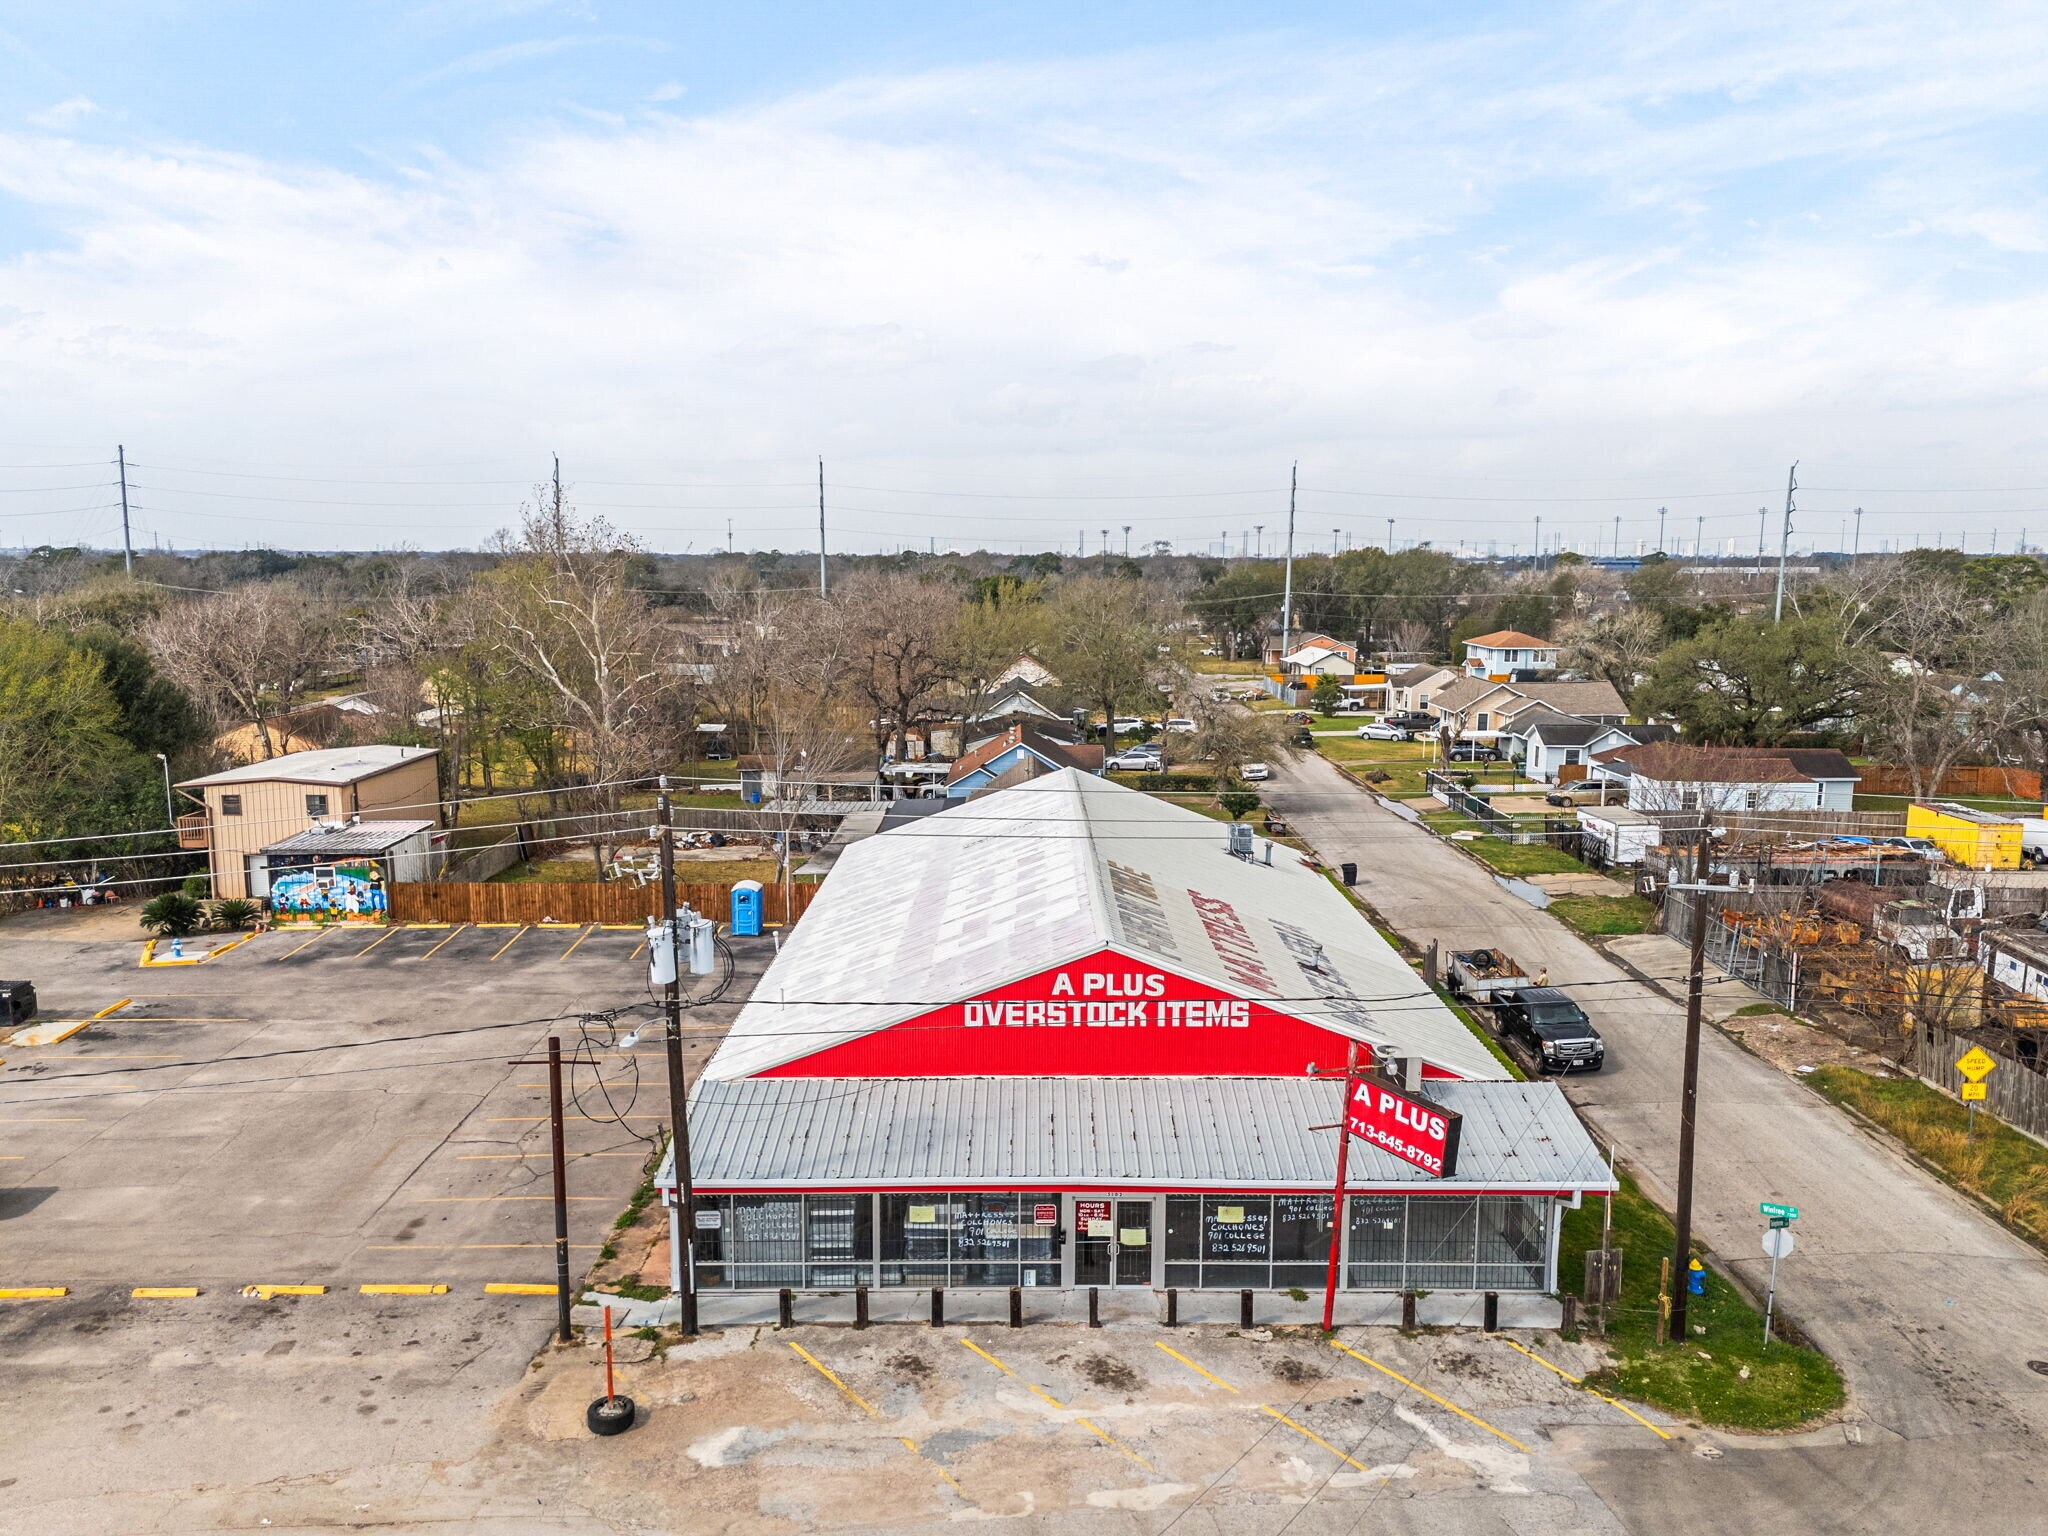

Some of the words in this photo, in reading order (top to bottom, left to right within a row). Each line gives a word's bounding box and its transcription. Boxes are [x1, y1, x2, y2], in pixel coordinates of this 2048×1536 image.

[1187, 889, 1284, 999] MATTRESS
[1051, 973, 1075, 996] A
[1083, 973, 1165, 997] PLUS
[964, 1000, 1147, 1027] OVERSTOCK
[1157, 1001, 1250, 1027] ITEMS
[1353, 1083, 1371, 1107] A
[1379, 1092, 1445, 1140] PLUS
[1350, 1117, 1442, 1171] 713-645-8792
[1289, 1205, 1302, 1213] 901
[968, 1226, 984, 1237] 901
[1208, 1232, 1222, 1240] 901
[958, 1238, 975, 1247] 832
[1211, 1244, 1230, 1252] 832
